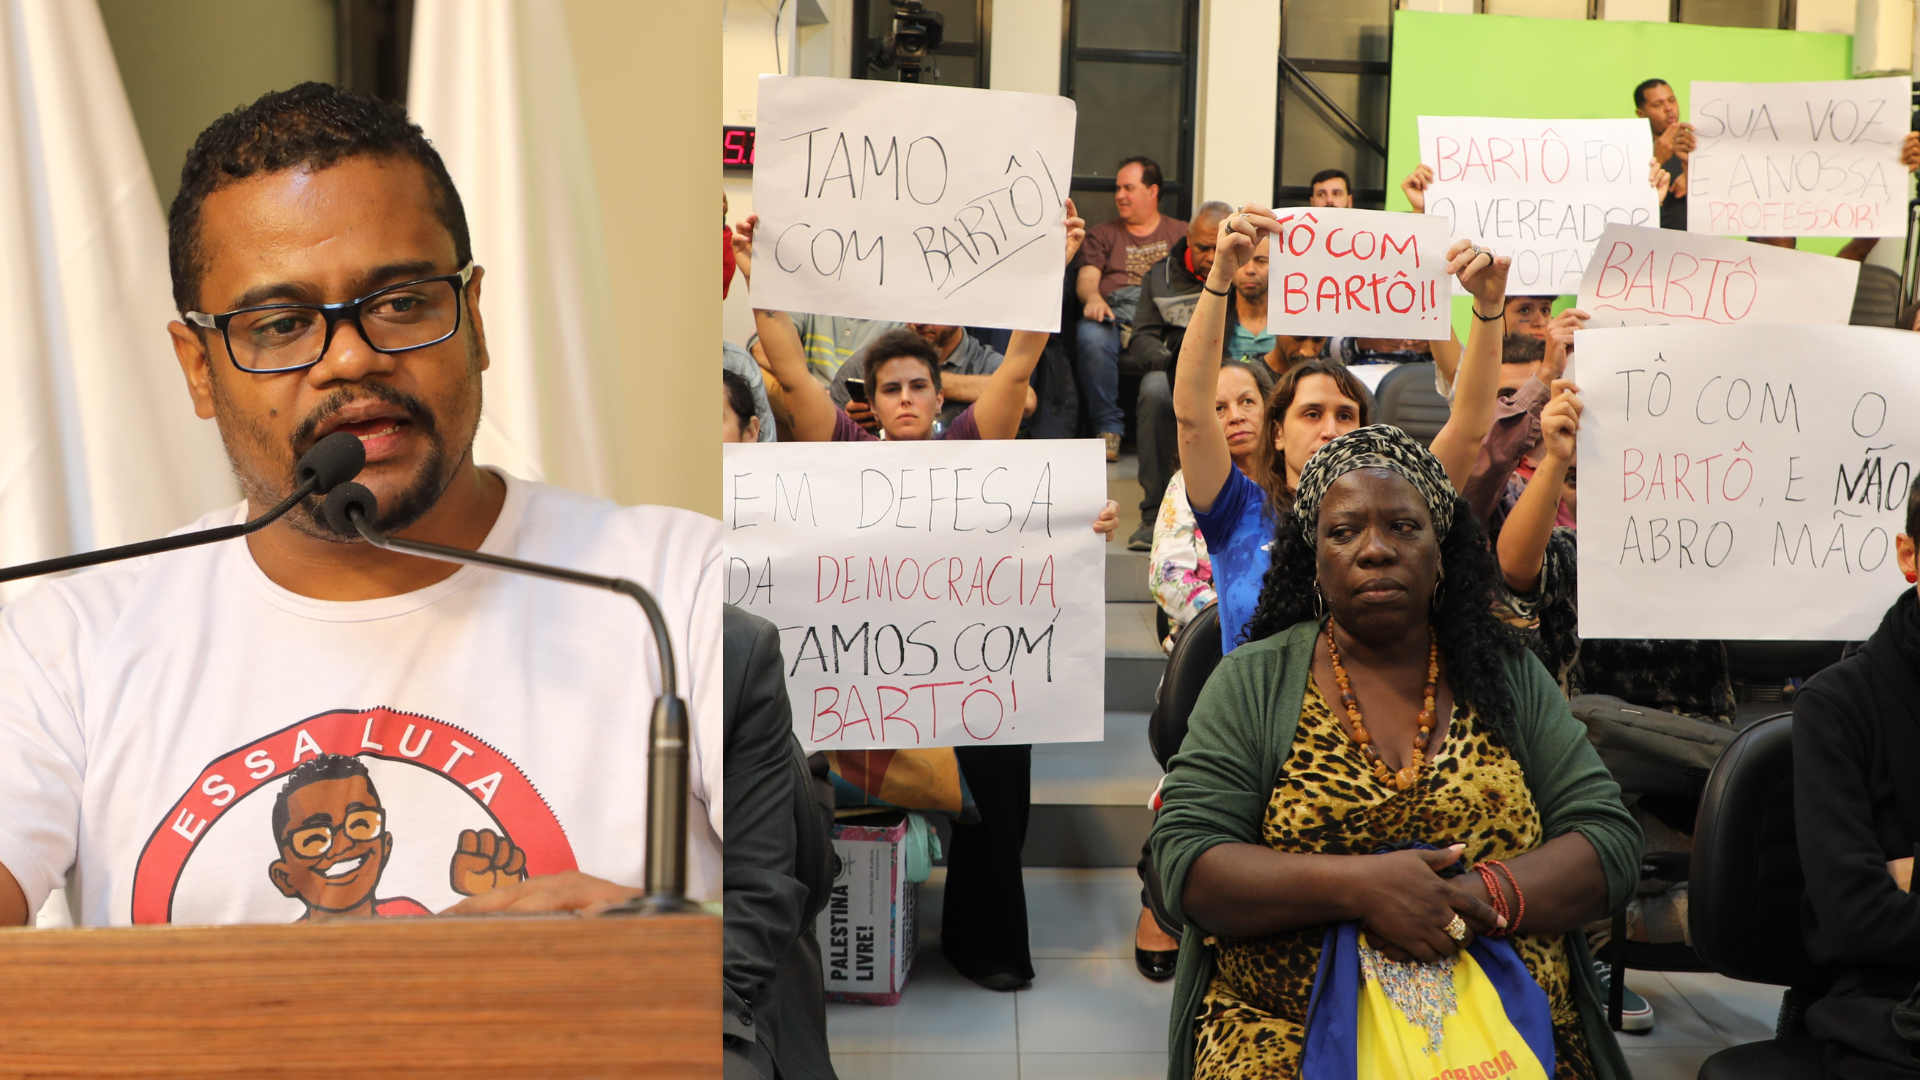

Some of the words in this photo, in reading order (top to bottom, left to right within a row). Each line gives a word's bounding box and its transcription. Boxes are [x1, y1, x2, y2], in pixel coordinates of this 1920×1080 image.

[1700, 98, 1779, 143] SUA
[1805, 98, 1893, 146] VOZ
[779, 126, 949, 206] TAMO
[1437, 127, 1570, 184] BARTÔ
[1584, 140, 1632, 185] FOI
[1691, 139, 1719, 197] É
[1276, 212, 1318, 257] TÔ
[1325, 227, 1419, 268] COM
[1708, 200, 1880, 232] PROFESSOR!
[774, 222, 884, 286] COM
[1596, 241, 1757, 320] BARTÔ
[1284, 270, 1438, 321] BARTÔ!!
[1616, 352, 1672, 421] TÔ
[1696, 375, 1800, 433] COM
[1851, 391, 1887, 438] O
[732, 472, 818, 531] EM
[857, 462, 1054, 538] DEFESA
[1622, 441, 1764, 508] BARTÔ,
[1785, 456, 1806, 502] E
[1833, 444, 1911, 514] NÃO
[1620, 516, 1734, 569] ABRO
[1773, 510, 1889, 574] MÃO
[728, 556, 775, 606] DA
[779, 620, 939, 678] AMOS
[811, 676, 1018, 744] BARTÔ!
[172, 729, 324, 843] ESSA
[360, 717, 504, 807] LUTA
[830, 884, 849, 981] PALESTINA
[856, 925, 874, 982] LIVRE!
[1431, 1050, 1518, 1080] CRACIA
